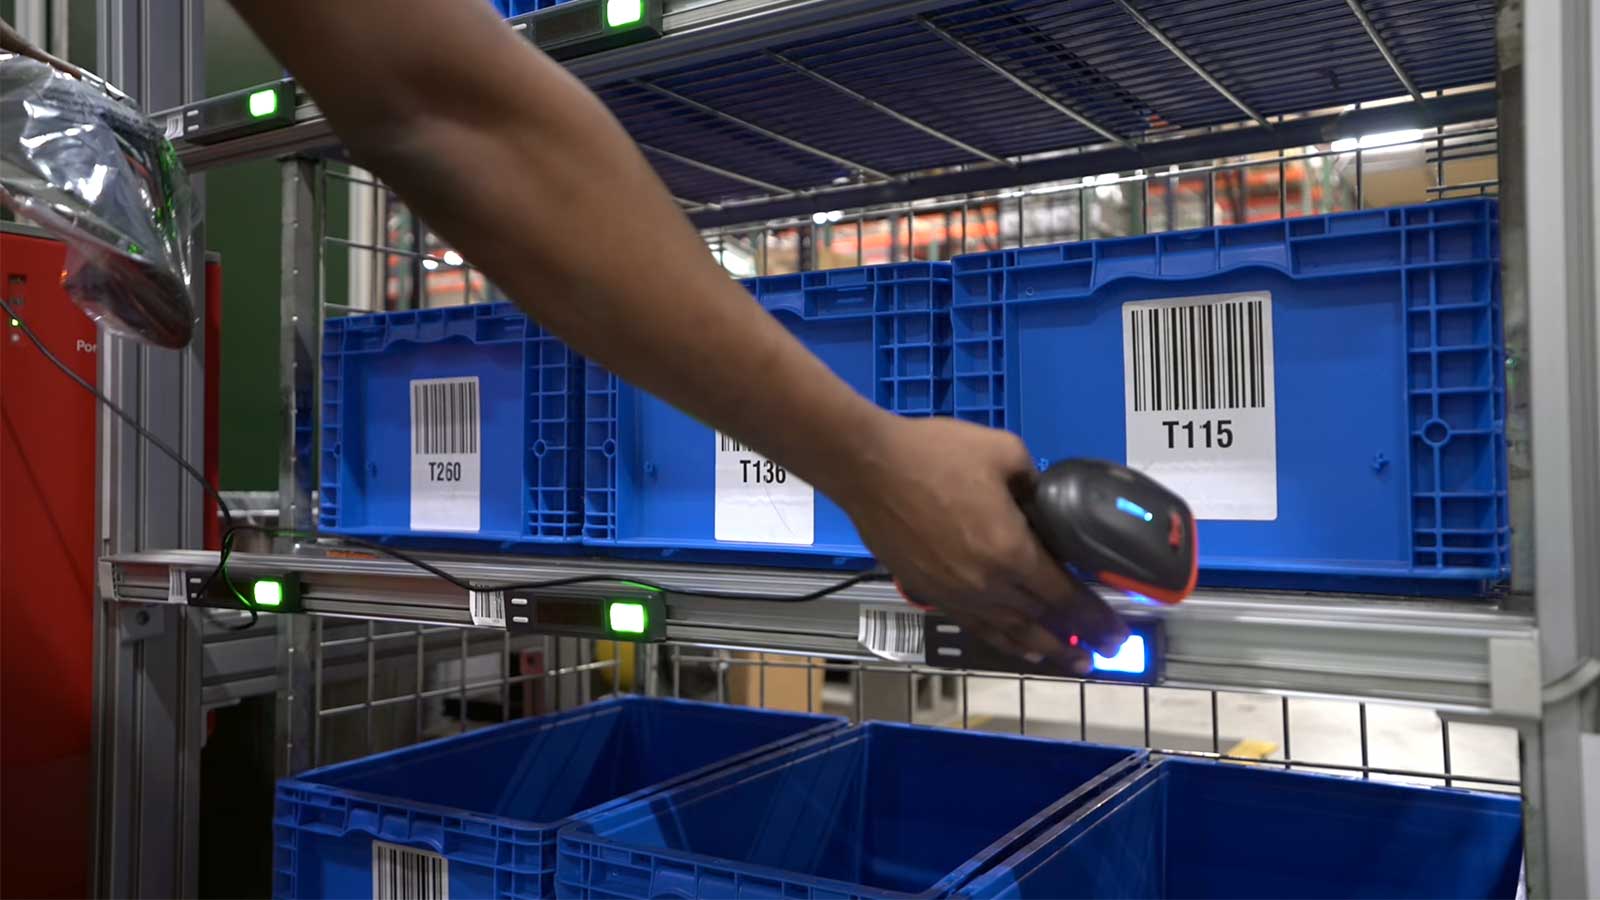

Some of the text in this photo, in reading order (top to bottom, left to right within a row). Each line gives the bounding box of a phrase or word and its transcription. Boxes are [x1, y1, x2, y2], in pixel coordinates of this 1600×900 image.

[1162, 419, 1234, 449] T115
[428, 461, 462, 482] T260
[739, 459, 786, 484] T136
